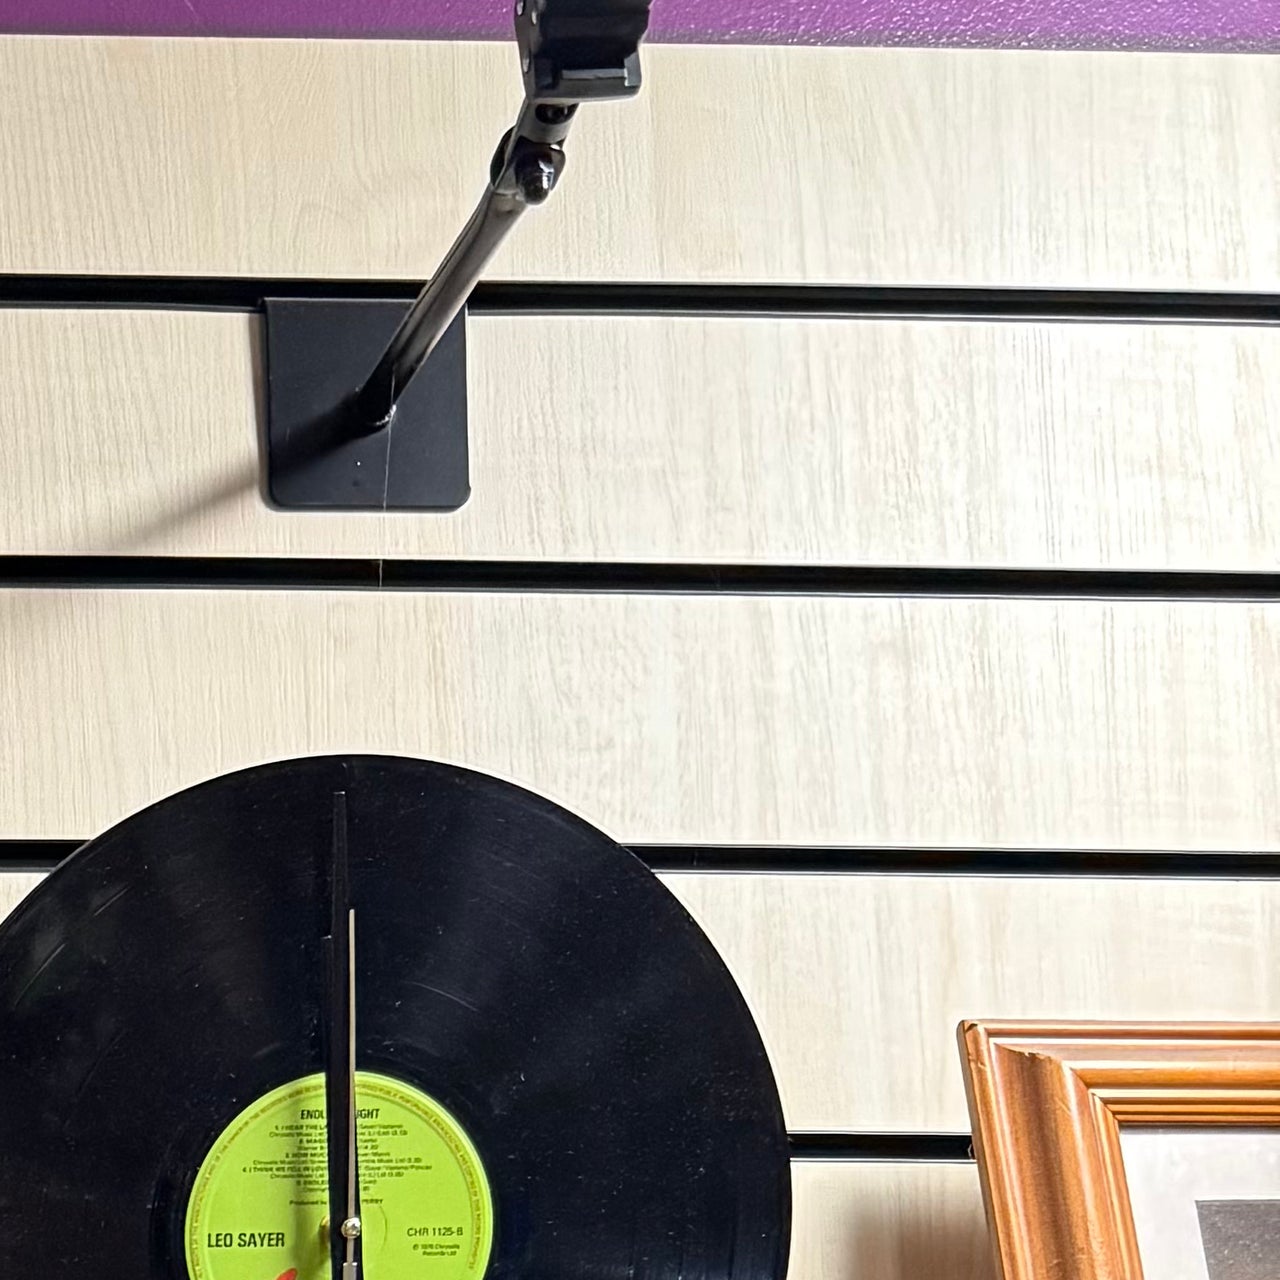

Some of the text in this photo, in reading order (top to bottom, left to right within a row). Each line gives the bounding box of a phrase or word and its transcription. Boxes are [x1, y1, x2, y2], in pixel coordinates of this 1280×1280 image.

[407, 1228, 429, 1237] CHR
[207, 1233, 285, 1247] LEO SAYER
